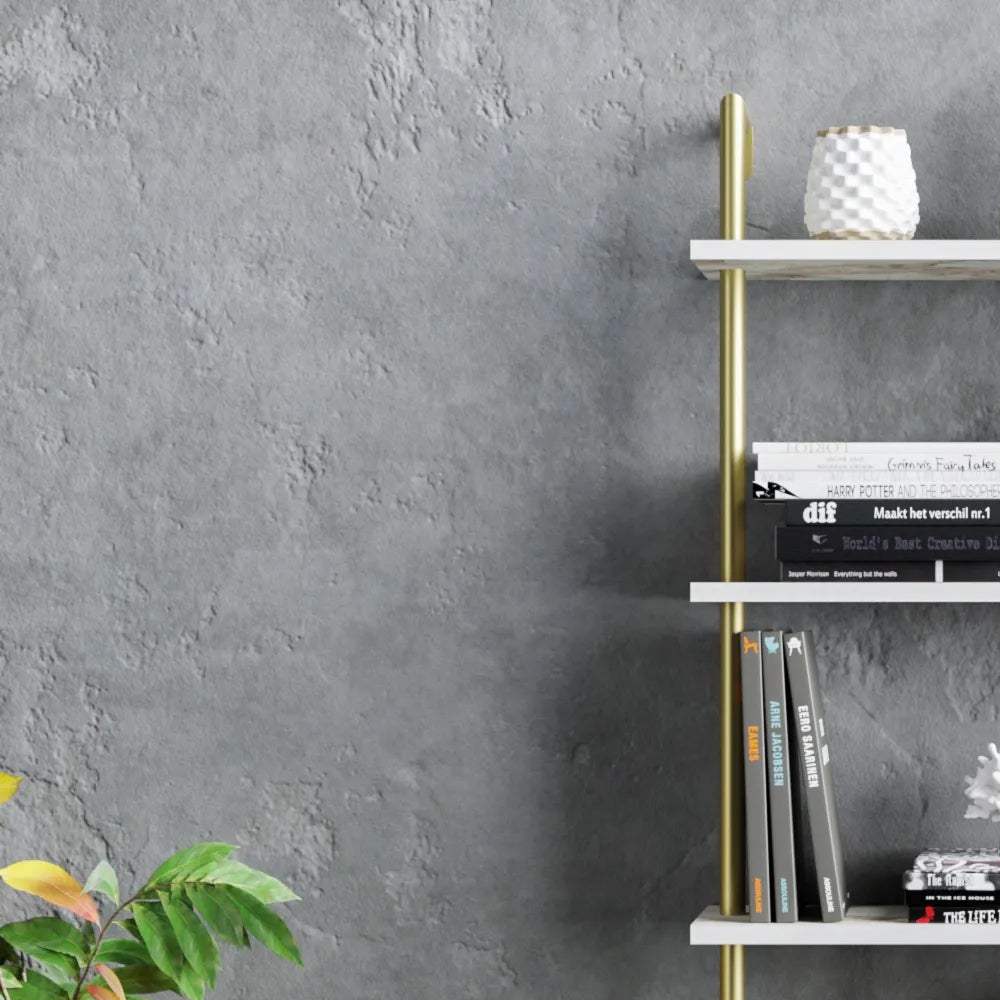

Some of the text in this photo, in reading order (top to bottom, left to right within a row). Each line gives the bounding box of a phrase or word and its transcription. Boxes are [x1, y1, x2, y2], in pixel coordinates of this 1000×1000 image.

[935, 456, 965, 472] Fairy
[965, 453, 997, 470] Tales
[827, 484, 855, 498] HARRY
[859, 484, 895, 498] POTTER
[898, 484, 918, 498] AND
[920, 484, 938, 498] THE
[802, 501, 837, 524] dif
[873, 506, 991, 520] Maakt het verschil nr.1
[842, 535, 888, 549] World's
[895, 536, 921, 549] Best
[927, 535, 981, 549] Creative
[788, 570, 898, 579] Jasper Morrison Everything but the walls
[747, 725, 760, 762] EAMES
[769, 700, 784, 787] ARNE JACOBSEN
[797, 705, 820, 788] EERO SAARINEN
[927, 873, 942, 886] The
[943, 911, 966, 923] THE
[968, 910, 996, 923] LIFE
